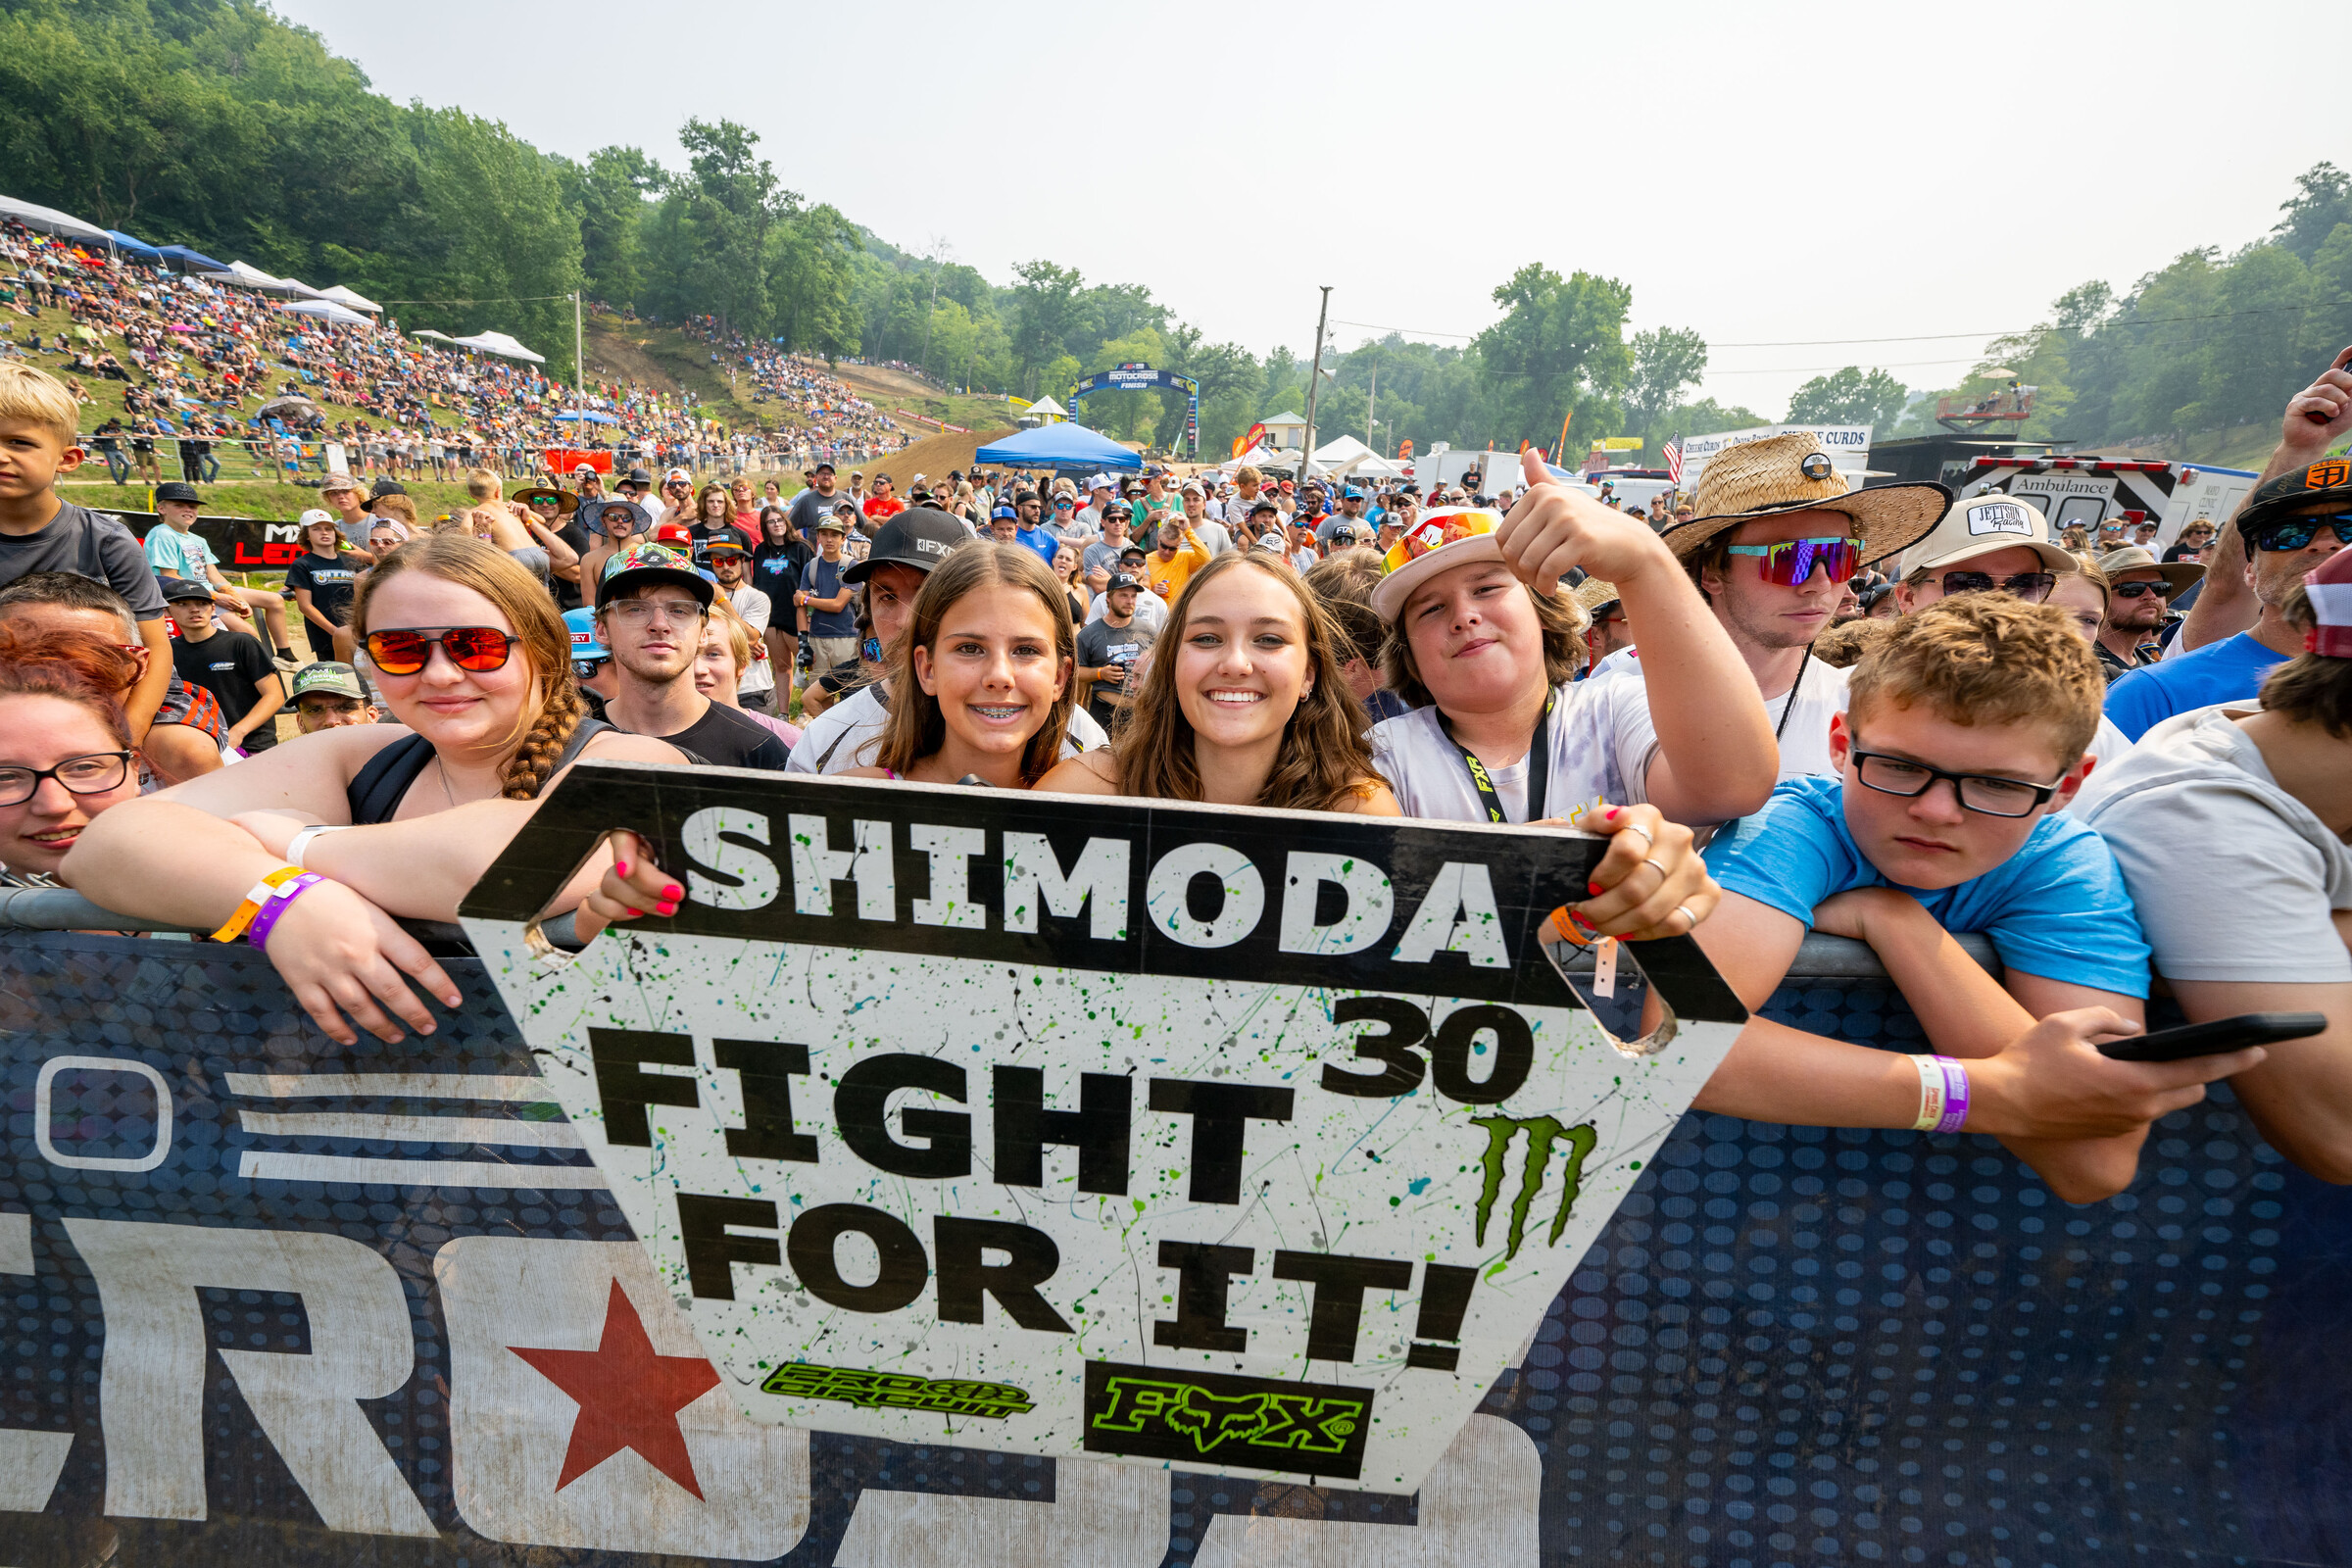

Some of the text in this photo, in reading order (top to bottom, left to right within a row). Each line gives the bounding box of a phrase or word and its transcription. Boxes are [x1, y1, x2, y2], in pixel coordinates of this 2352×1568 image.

[1826, 431, 1865, 445] CURDS
[2017, 477, 2109, 494] Ambulance
[1980, 505, 2021, 522] JETTSON
[1990, 517, 2024, 531] Racing
[1465, 756, 1494, 793] FXR
[680, 806, 1511, 970] SHIMODA
[1320, 996, 1535, 1104] 30
[590, 1027, 1294, 1205] FIGHT
[677, 1192, 1479, 1372] FOR IT!
[761, 1377, 1037, 1418] CIRCUIT
